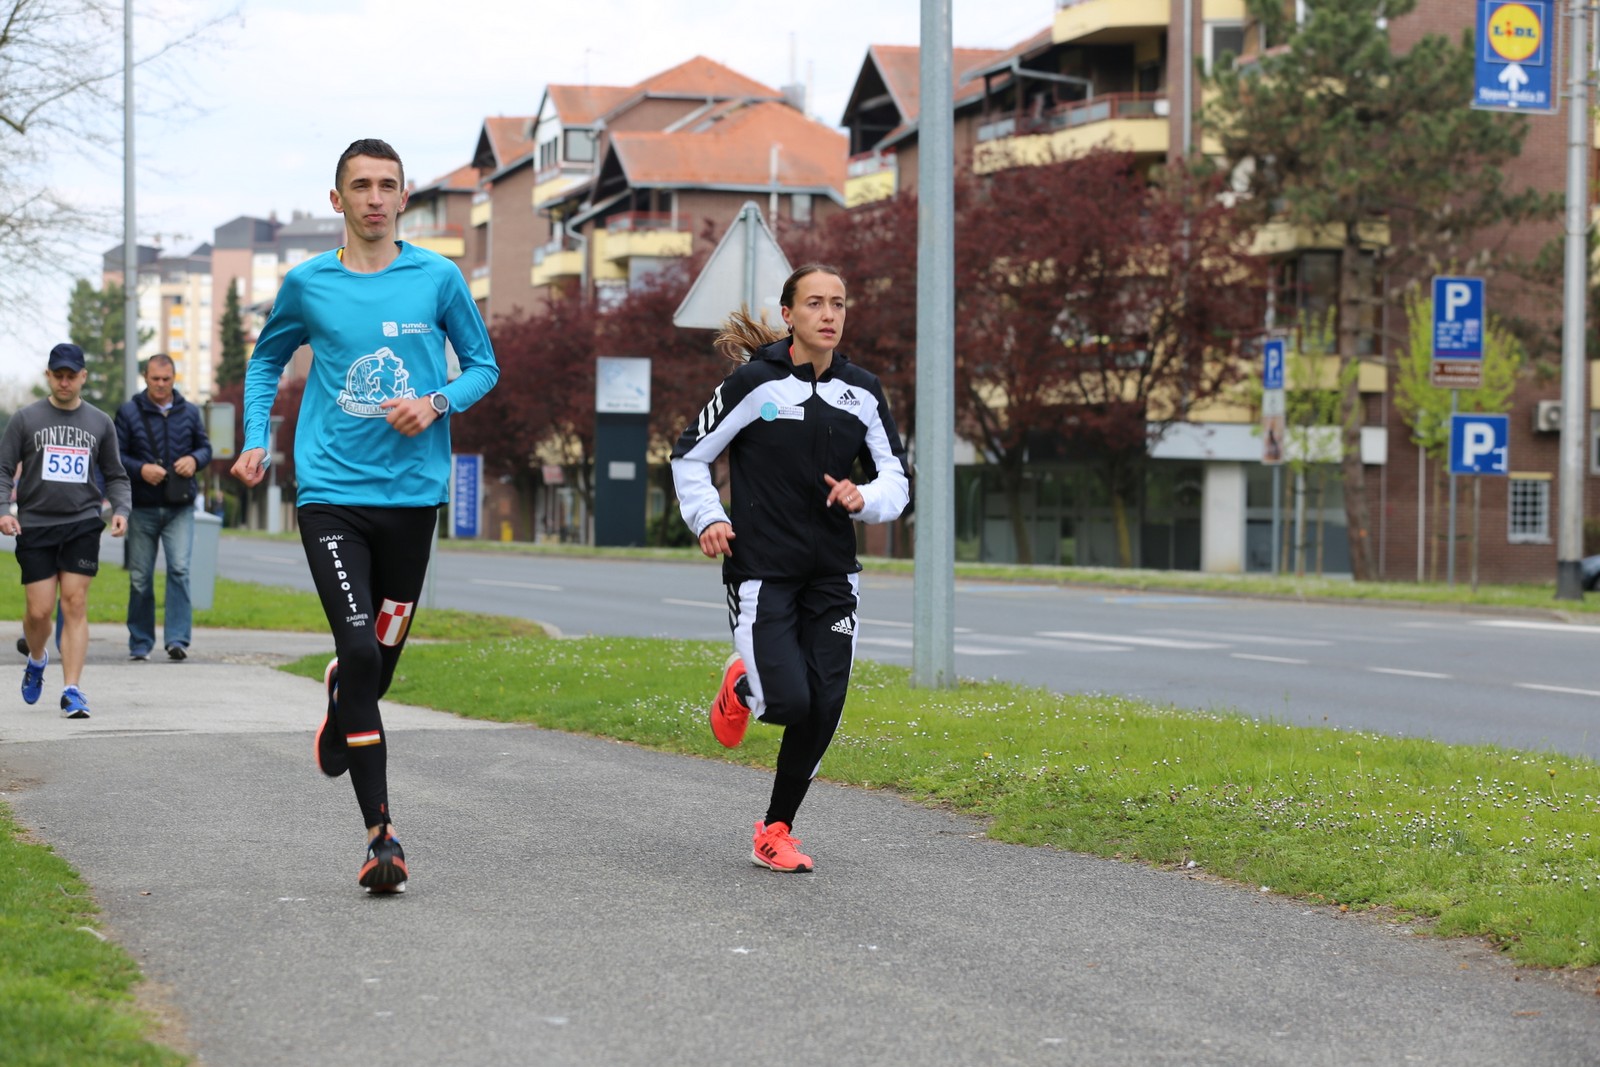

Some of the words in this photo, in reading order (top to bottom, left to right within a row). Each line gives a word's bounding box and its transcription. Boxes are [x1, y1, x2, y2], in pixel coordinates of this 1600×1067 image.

[1446, 282, 1472, 321] P
[1463, 422, 1496, 466] P
[48, 454, 84, 475] 536
[319, 534, 344, 543] HAAK
[345, 613, 369, 623] ZAGREB
